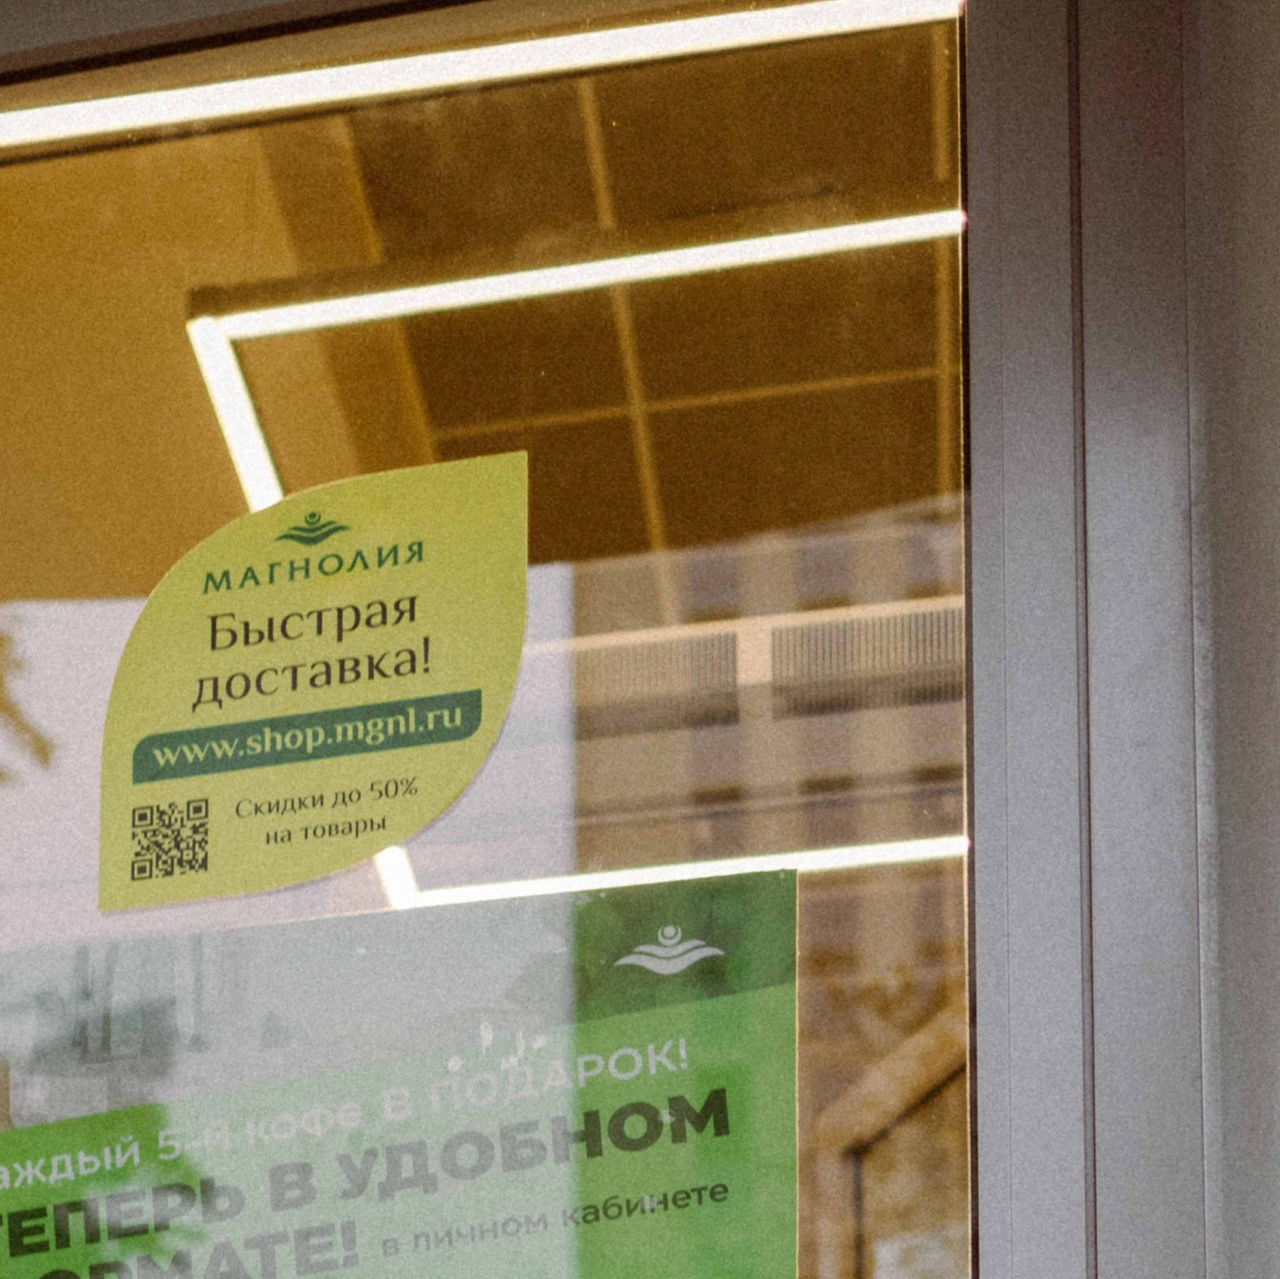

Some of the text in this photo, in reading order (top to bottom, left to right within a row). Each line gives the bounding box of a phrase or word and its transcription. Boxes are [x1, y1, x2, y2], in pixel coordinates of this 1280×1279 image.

[203, 541, 424, 594] МАГНОЛИЯ
[208, 595, 418, 651] Быстрая
[192, 636, 430, 713] доставка!
[153, 704, 462, 766] www.shop.mgnl.ru
[235, 776, 418, 819] Скидки до 50%
[266, 816, 387, 845] на товары
[248, 1100, 362, 1145] кофе
[431, 1038, 689, 1110] ПОДАРОК!
[268, 1161, 317, 1211] В
[337, 1088, 730, 1202] УДОБНОМ
[382, 1237, 399, 1258] в
[412, 1211, 548, 1254] личном
[562, 1183, 729, 1228] кабинете
